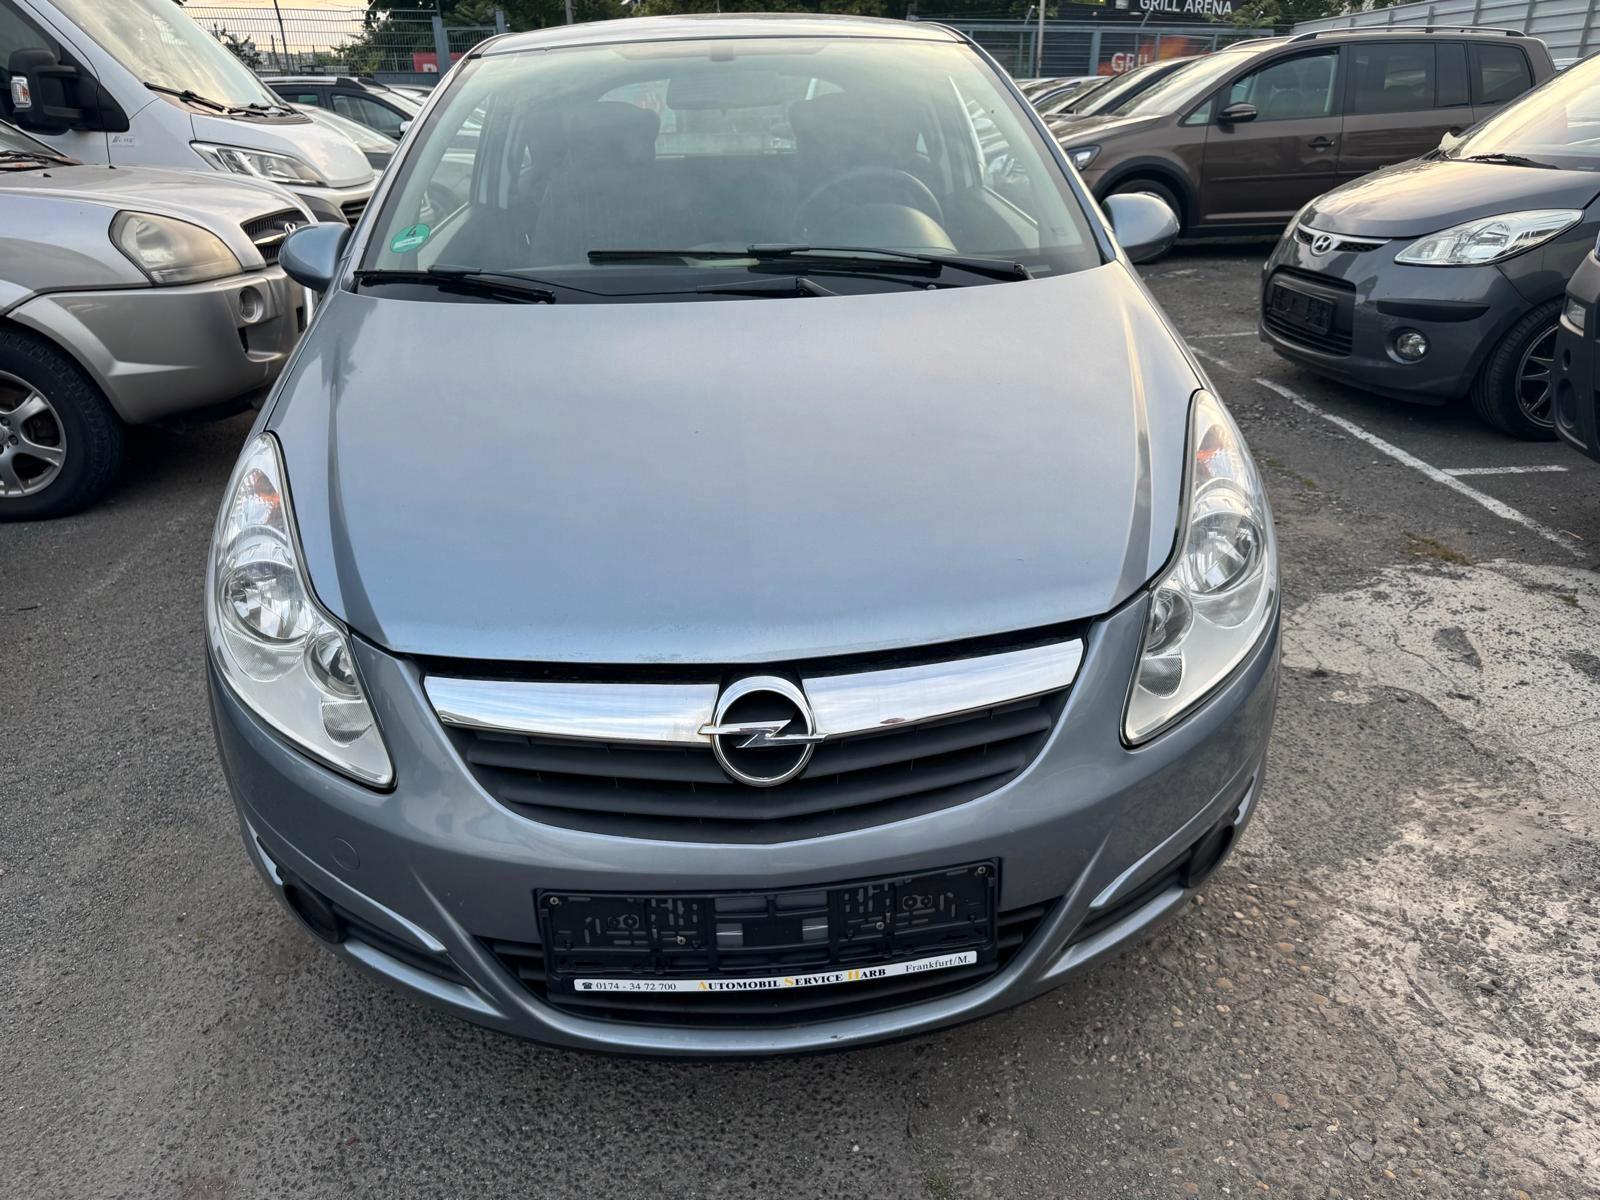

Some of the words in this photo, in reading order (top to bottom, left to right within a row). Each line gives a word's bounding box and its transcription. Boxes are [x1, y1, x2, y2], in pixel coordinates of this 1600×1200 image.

[1139, 0, 1181, 12] GRILL
[1183, 0, 1232, 15] ARENA
[595, 982, 619, 990] 0174
[629, 982, 641, 991] 34
[644, 983, 656, 991] 72
[658, 983, 677, 991] 700
[784, 973, 844, 987] SERVICE
[847, 968, 887, 981] HARB
[905, 955, 972, 973] Frankfurt/M.
